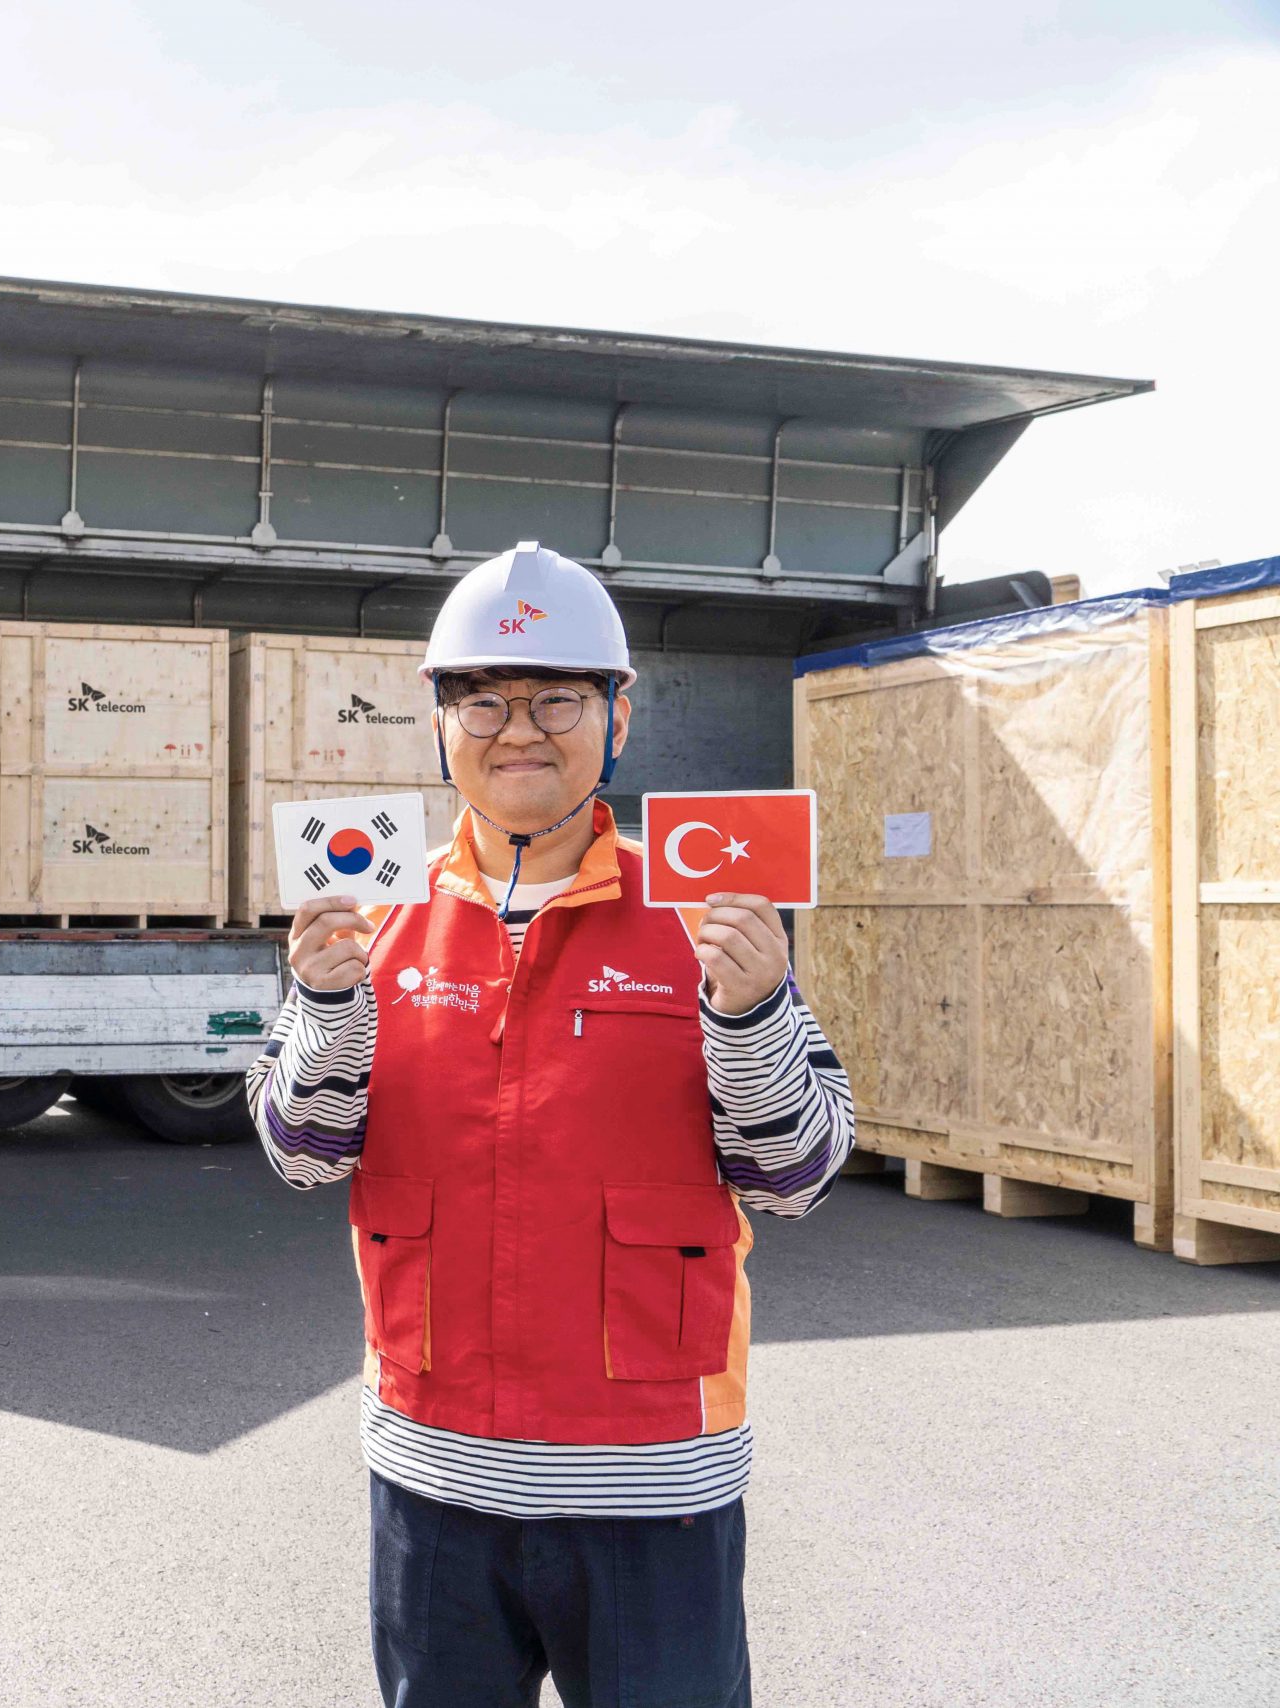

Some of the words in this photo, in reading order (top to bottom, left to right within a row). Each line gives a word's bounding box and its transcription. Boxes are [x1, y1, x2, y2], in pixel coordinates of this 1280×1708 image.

[499, 618, 526, 635] SK
[68, 697, 89, 712] SK
[96, 701, 146, 713] telecom
[338, 709, 359, 724] SK
[366, 712, 416, 725] telecom
[72, 840, 93, 854] SK
[100, 843, 150, 855] telecom
[459, 983, 481, 998] 마음
[588, 979, 611, 993] SK
[618, 980, 673, 994] telecom
